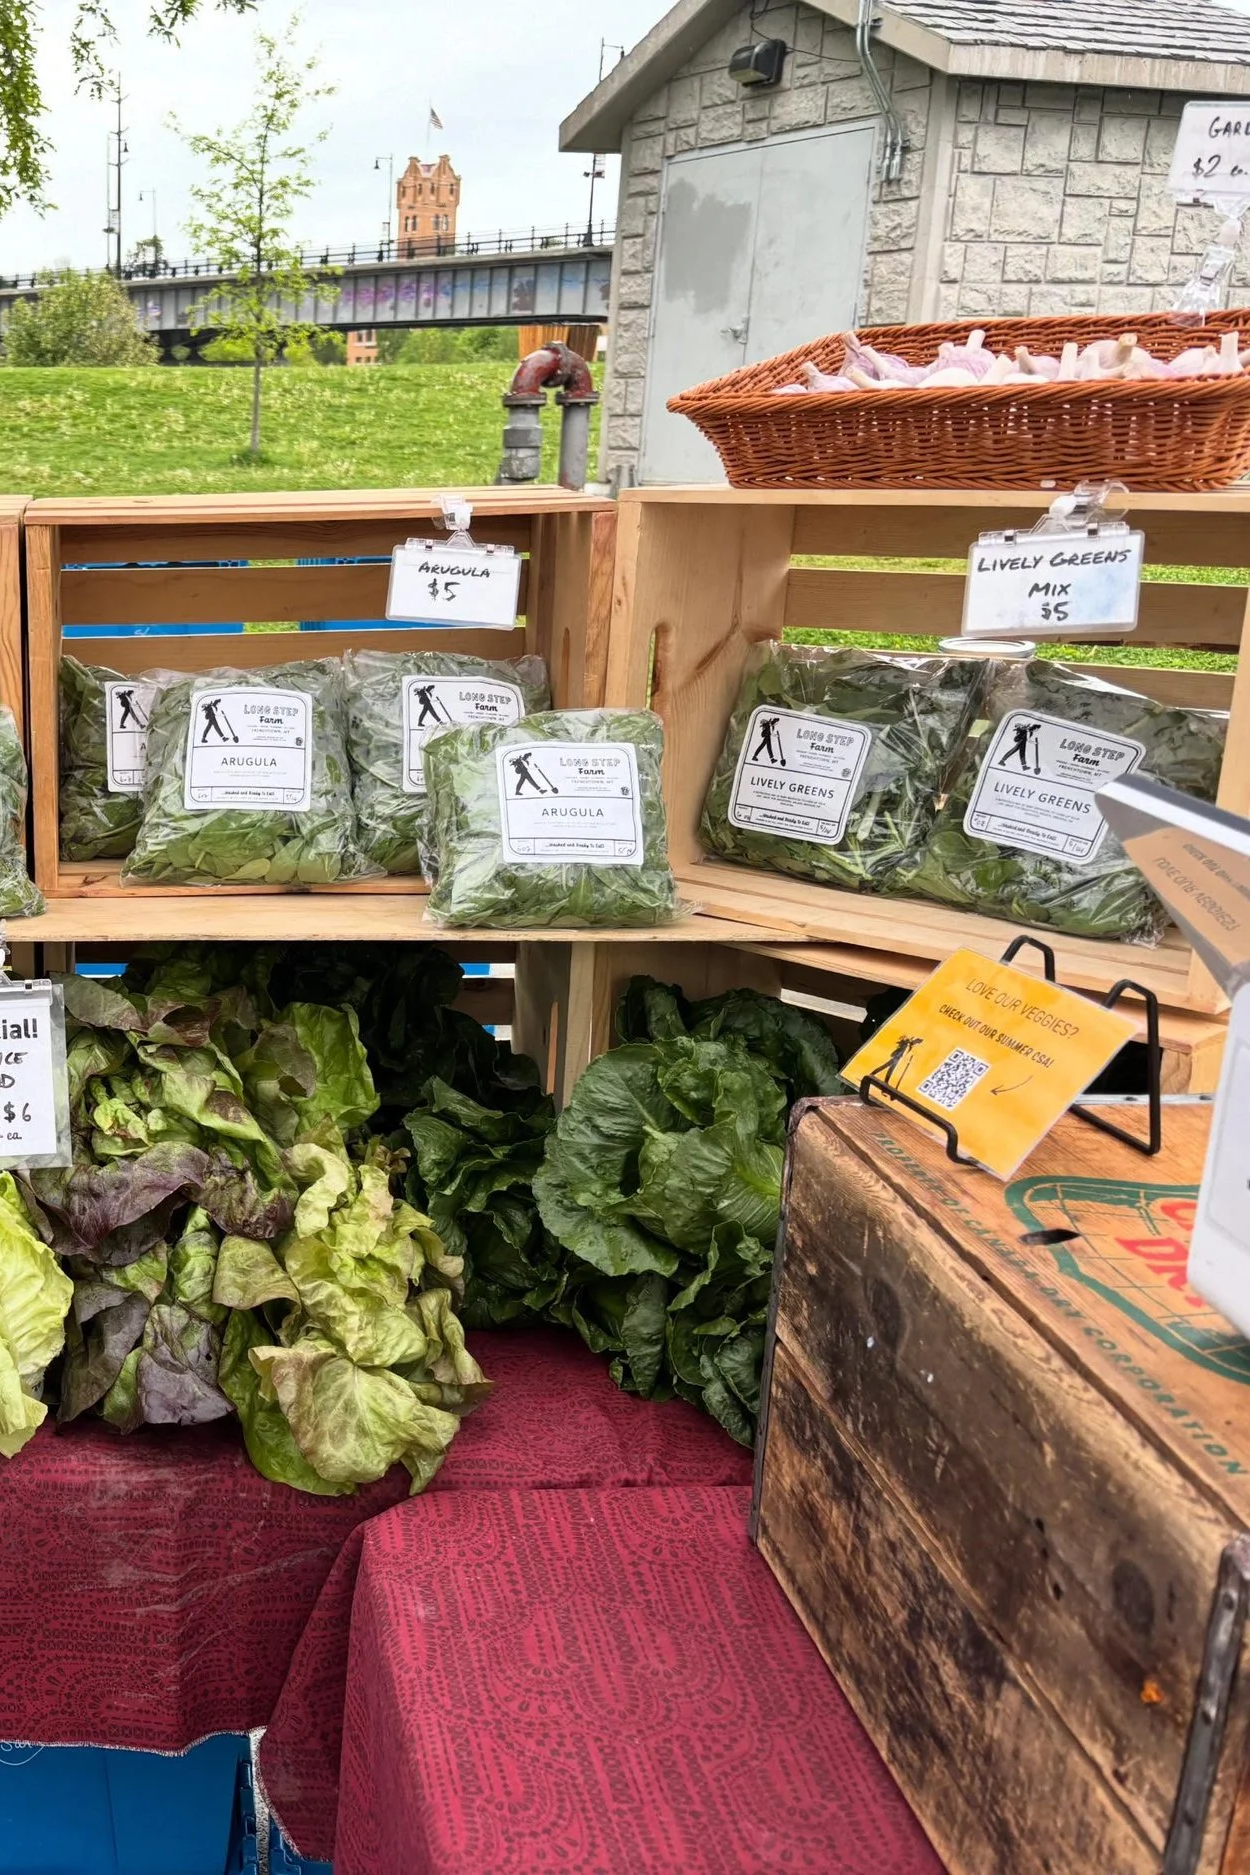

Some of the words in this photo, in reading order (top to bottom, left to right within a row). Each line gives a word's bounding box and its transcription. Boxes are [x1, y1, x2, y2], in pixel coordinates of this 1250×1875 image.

[1192, 154, 1222, 178] $2
[977, 555, 1044, 573] LIVELY
[1050, 549, 1132, 567] GREENS
[418, 561, 491, 578] ARUGULA
[427, 578, 461, 602] $5
[1028, 582, 1072, 598] MIX
[1041, 601, 1070, 621] $5
[459, 691, 485, 703] LONG
[487, 694, 512, 705] STEP
[243, 703, 272, 716] LONG
[273, 705, 299, 717] STEP
[475, 703, 498, 712] Farm
[259, 715, 284, 725] Farm
[796, 728, 823, 742] LONG
[825, 733, 855, 747] STEP
[810, 742, 835, 754] Farm
[1059, 738, 1091, 755] LONG
[1092, 746, 1125, 761] STEP
[221, 757, 278, 767] ARUGULA
[559, 757, 589, 767] LONG
[591, 757, 621, 767] STEP
[1072, 753, 1100, 767] Farm
[578, 767, 605, 776] Farm
[750, 776, 786, 790] LIVELY
[789, 783, 835, 799] GREENS
[993, 782, 1036, 799] LIVELY
[1038, 793, 1092, 814] GREENS
[541, 807, 605, 818] ARUGULA
[966, 978, 996, 1004] LOVE
[994, 992, 1020, 1013] OUR
[1020, 1003, 1080, 1040] VEGGIES?
[938, 1003, 964, 1025] CHECK
[962, 1015, 981, 1033] OUT
[978, 1022, 998, 1040] OUR
[995, 1031, 1035, 1058] SUMMER
[1032, 1049, 1056, 1068] CSA!
[6, 1131, 23, 1141] ea.
[1038, 1286, 1086, 1320] DRY
[1082, 1327, 1248, 1476] CORPORATION
